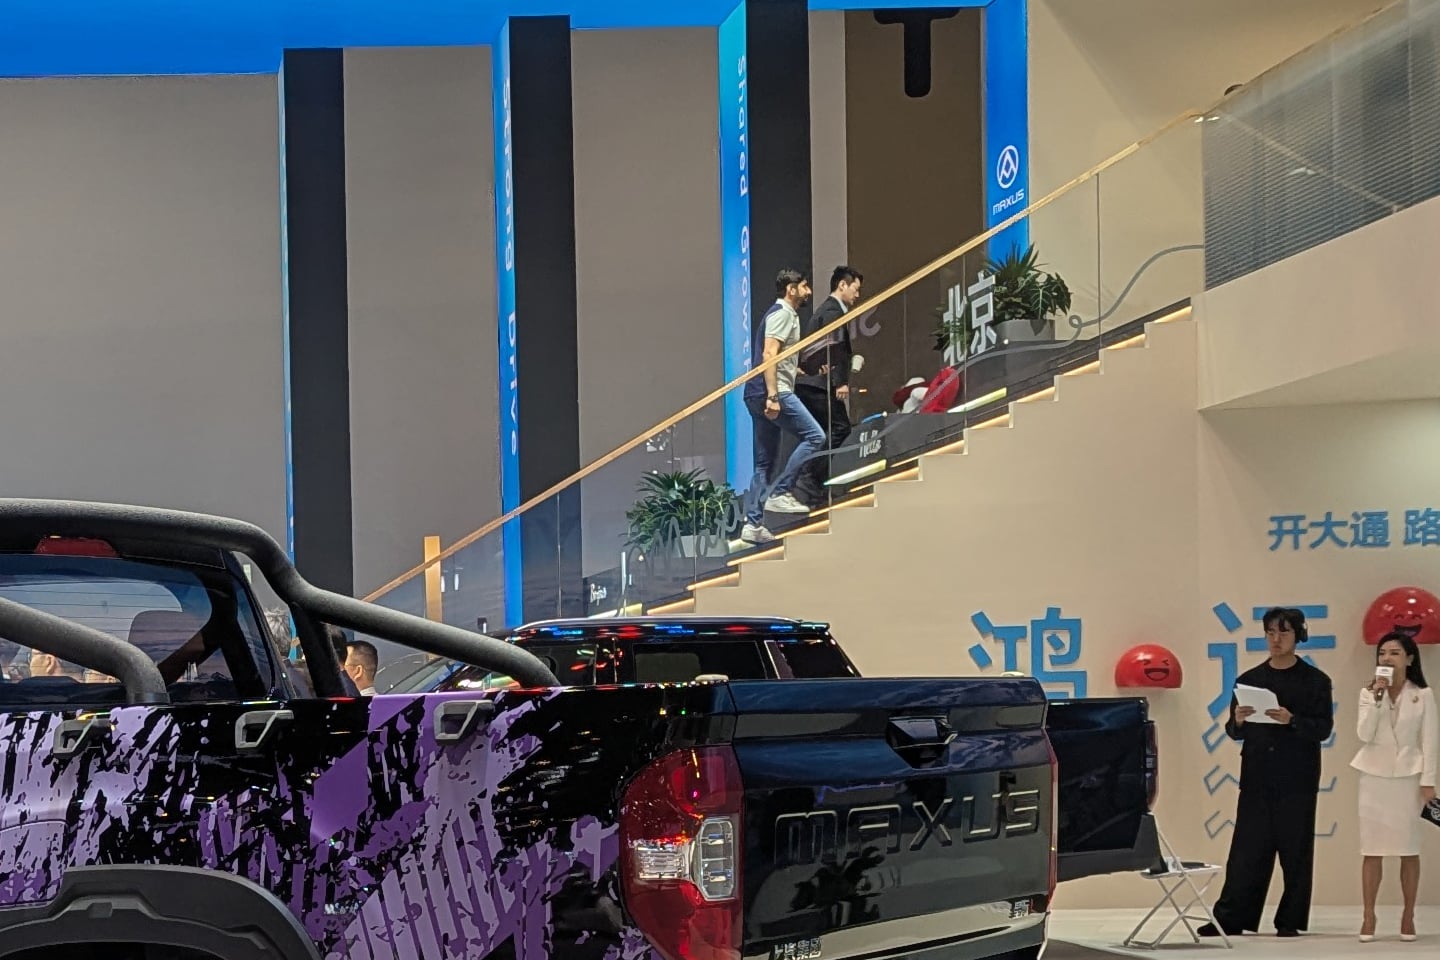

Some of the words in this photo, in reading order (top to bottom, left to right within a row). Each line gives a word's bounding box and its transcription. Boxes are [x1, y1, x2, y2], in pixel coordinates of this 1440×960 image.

[737, 55, 748, 197] Shared
[992, 188, 1025, 216] MAXUS
[942, 269, 998, 368] 北京
[508, 311, 518, 456] Drive
[1268, 511, 1391, 551] 开大通
[774, 789, 1040, 864] MAXUS
